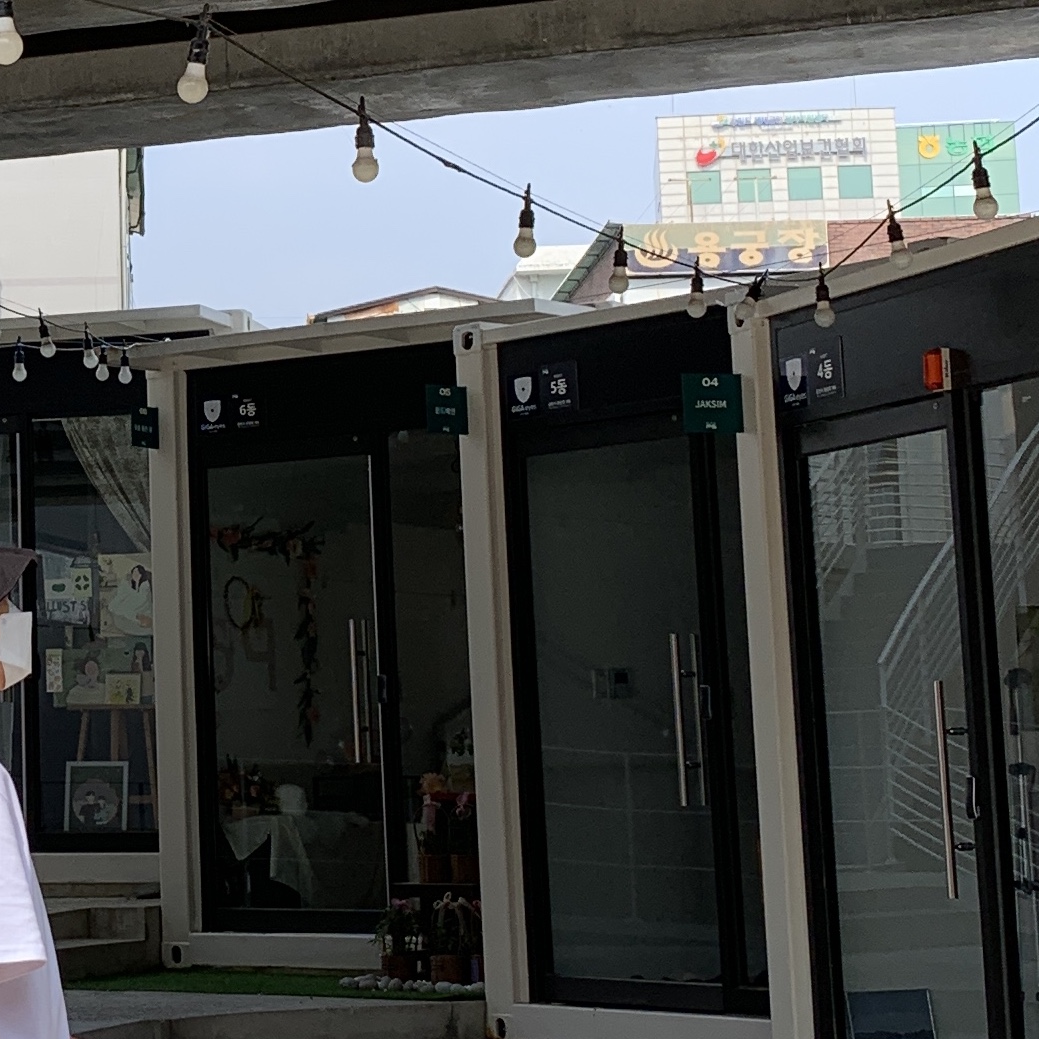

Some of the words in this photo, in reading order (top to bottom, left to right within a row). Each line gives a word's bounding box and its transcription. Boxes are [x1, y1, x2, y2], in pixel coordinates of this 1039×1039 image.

[730, 136, 868, 163] 대한산업보건협회
[687, 226, 820, 269] 용궁장
[817, 359, 834, 379] 4동
[550, 378, 568, 395] 5동
[701, 377, 719, 387] 04
[239, 402, 257, 417] 6동
[695, 400, 727, 409] JAKSIM
